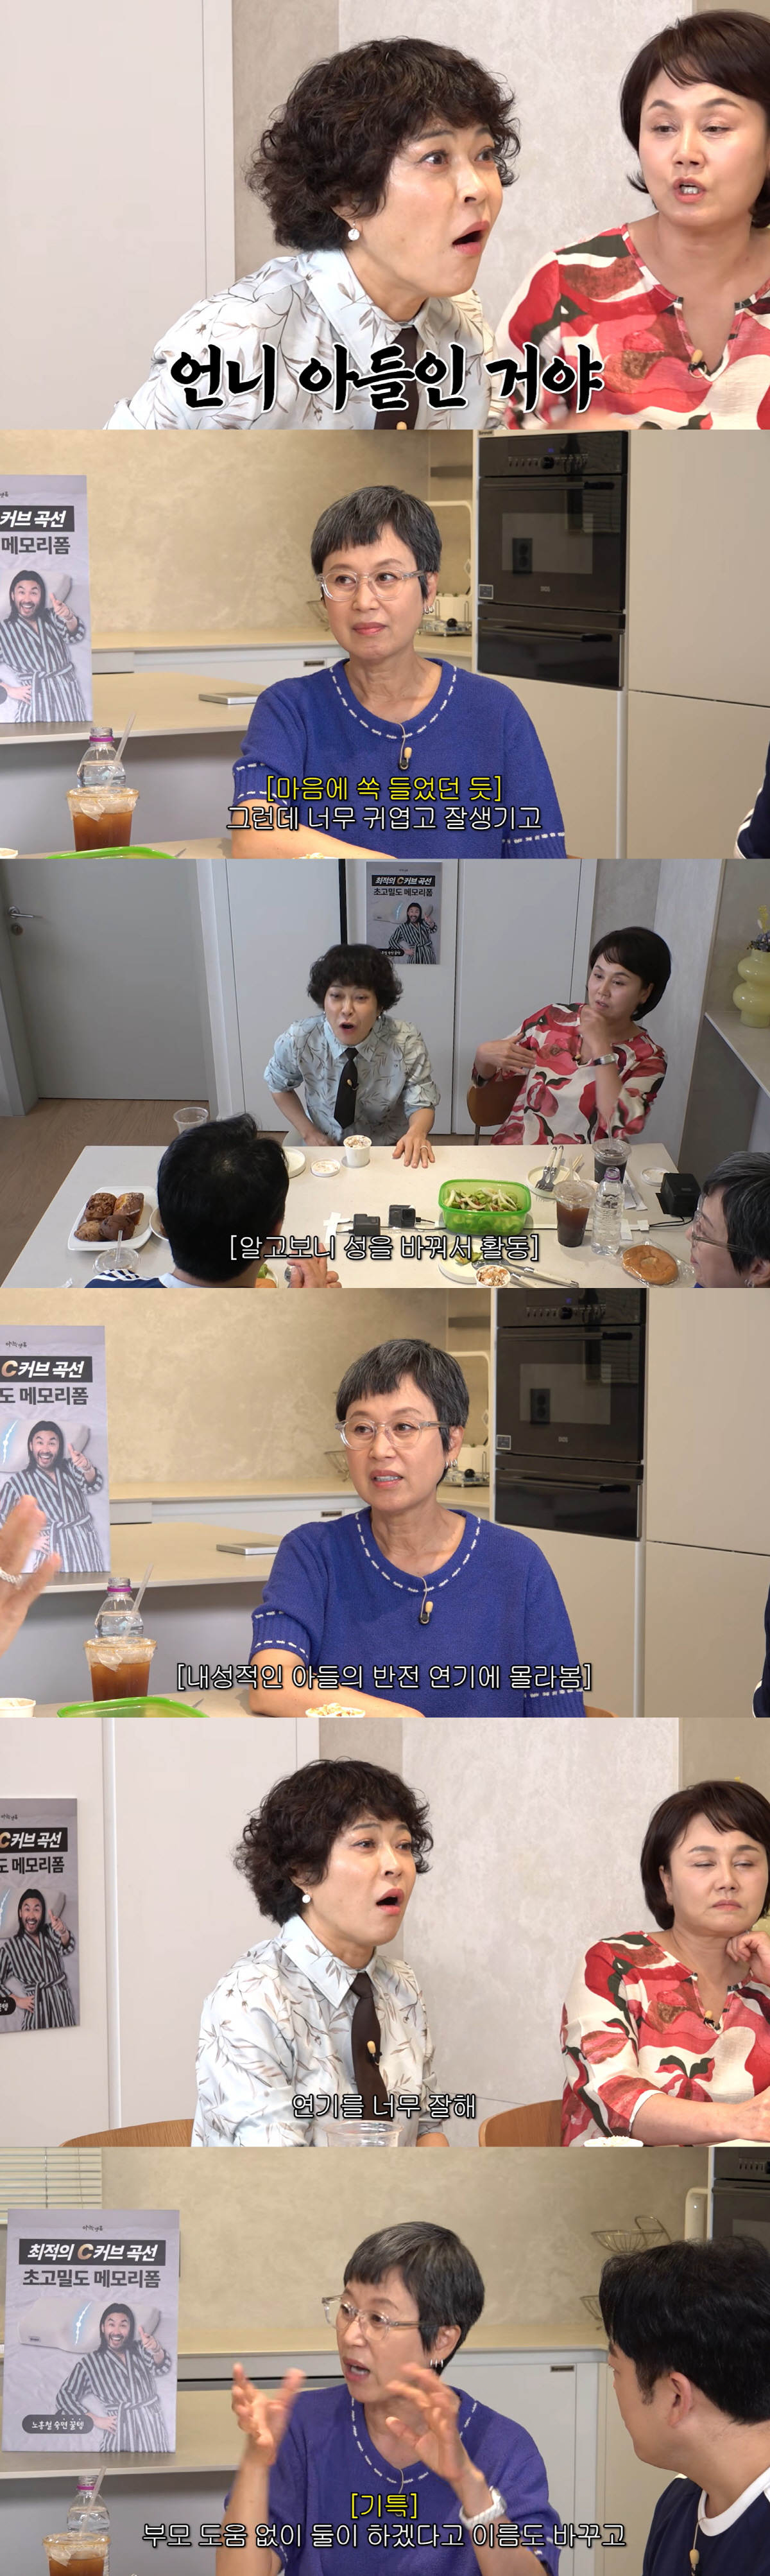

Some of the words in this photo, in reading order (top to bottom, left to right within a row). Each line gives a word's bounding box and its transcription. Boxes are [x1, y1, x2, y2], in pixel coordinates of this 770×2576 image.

[34, 510, 67, 528] 곡선
[1, 536, 71, 555] 메모리폼
[375, 876, 397, 885] 최적의
[397, 876, 418, 885] C커브
[418, 877, 432, 885] 곡선
[373, 888, 403, 896] 초고밀도
[404, 888, 433, 896] 메모리폼
[1, 1360, 51, 1379] C커브
[52, 1361, 85, 1379] 곡선
[20, 1387, 89, 1405] 메모리폼
[0, 1832, 36, 1849] C커브
[37, 1831, 62, 1849] 곡선
[12, 1856, 65, 1875] 메모리폼
[28, 2243, 75, 2261] 최적의
[77, 2243, 125, 2261] C커브
[126, 2244, 158, 2261] 곡선
[22, 2269, 90, 2288] 초고밀도
[94, 2270, 161, 2288] 메모리폼
[31, 2420, 53, 2430] 노홍철
[54, 2418, 68, 2430] 숙면
[69, 2418, 84, 2430] 꿀템
